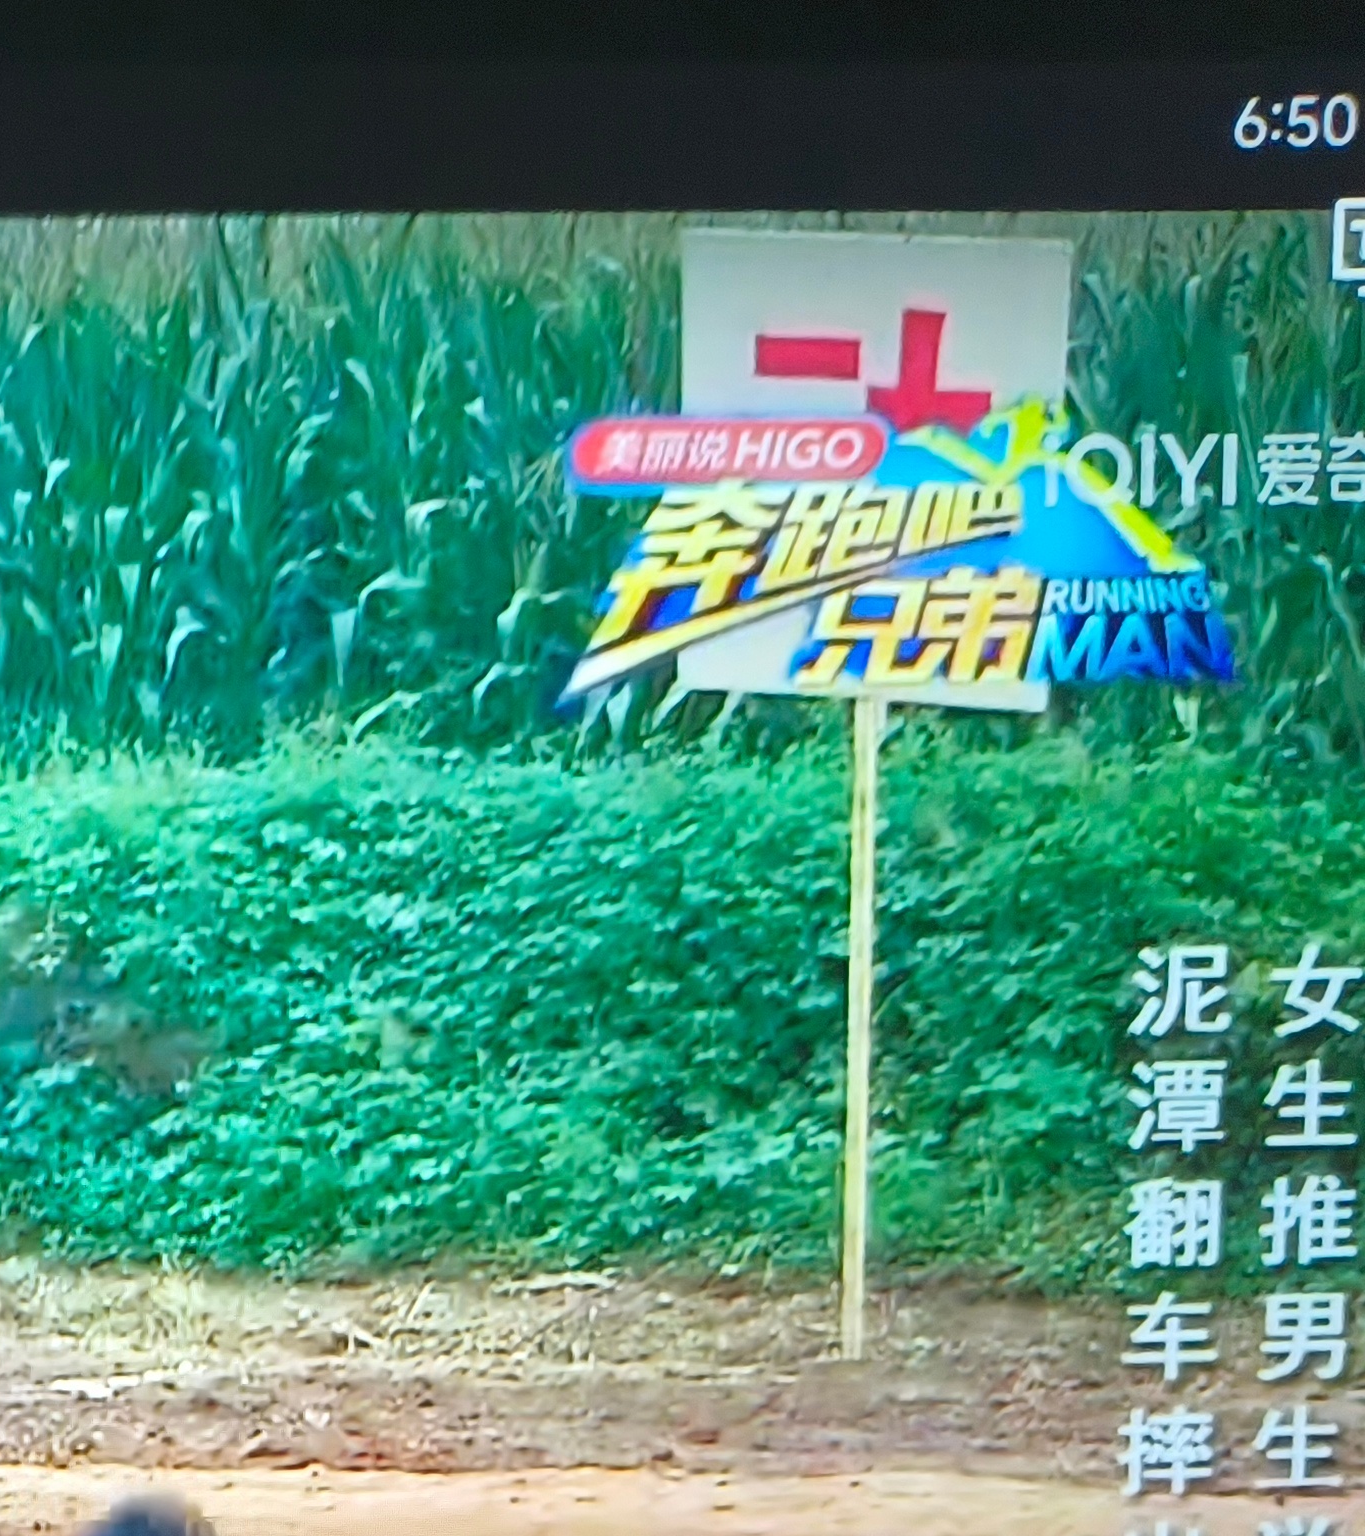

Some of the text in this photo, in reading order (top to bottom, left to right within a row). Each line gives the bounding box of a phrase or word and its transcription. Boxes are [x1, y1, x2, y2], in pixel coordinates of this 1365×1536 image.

[1234, 93, 1359, 148] 6:50
[733, 427, 864, 471] HIGO
[1042, 576, 1211, 614] RUNNING
[794, 562, 1045, 686] 兄弟
[1029, 612, 1234, 683] MAN
